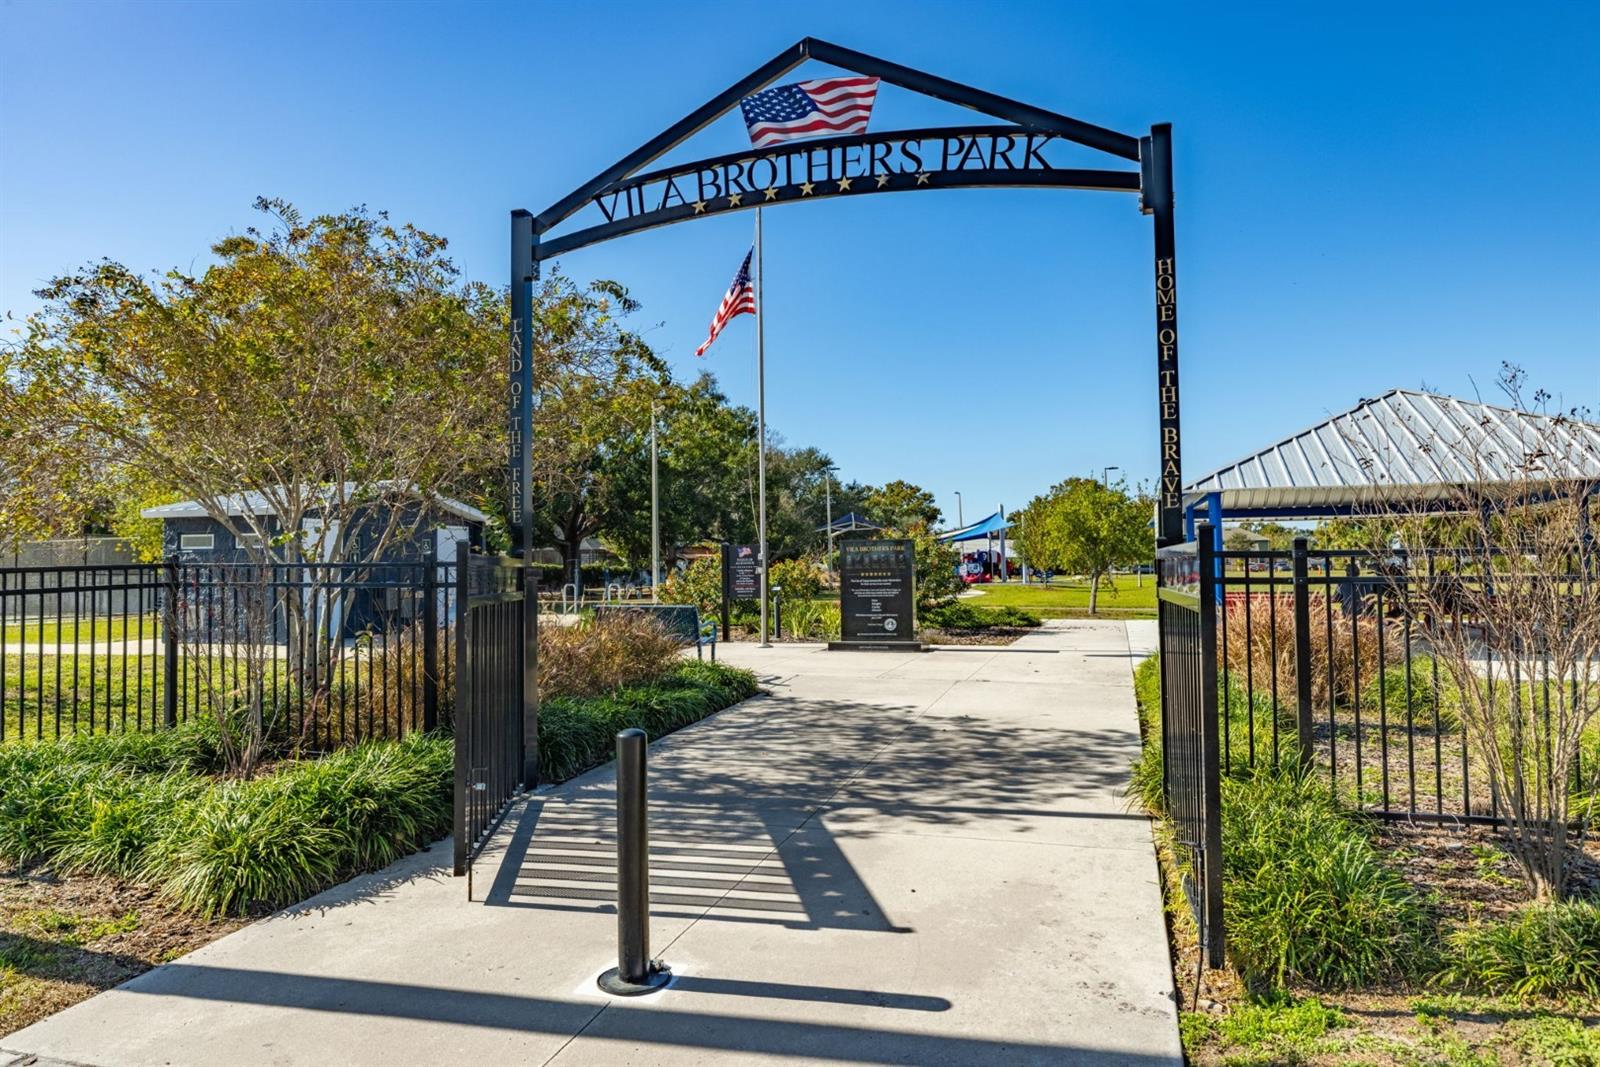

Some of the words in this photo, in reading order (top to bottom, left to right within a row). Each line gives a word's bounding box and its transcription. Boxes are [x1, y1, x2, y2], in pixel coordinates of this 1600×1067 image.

[595, 176, 697, 223] VILA
[698, 140, 923, 199] BROTHERS
[941, 134, 1055, 170] PARK
[1156, 258, 1176, 322] HOME
[511, 319, 523, 373] LAND
[1159, 328, 1176, 361] OF
[511, 381, 522, 410] OF
[1161, 370, 1177, 420] THE
[511, 416, 522, 459] THE
[1163, 427, 1180, 509] BRAVE
[512, 467, 522, 524] FREE
